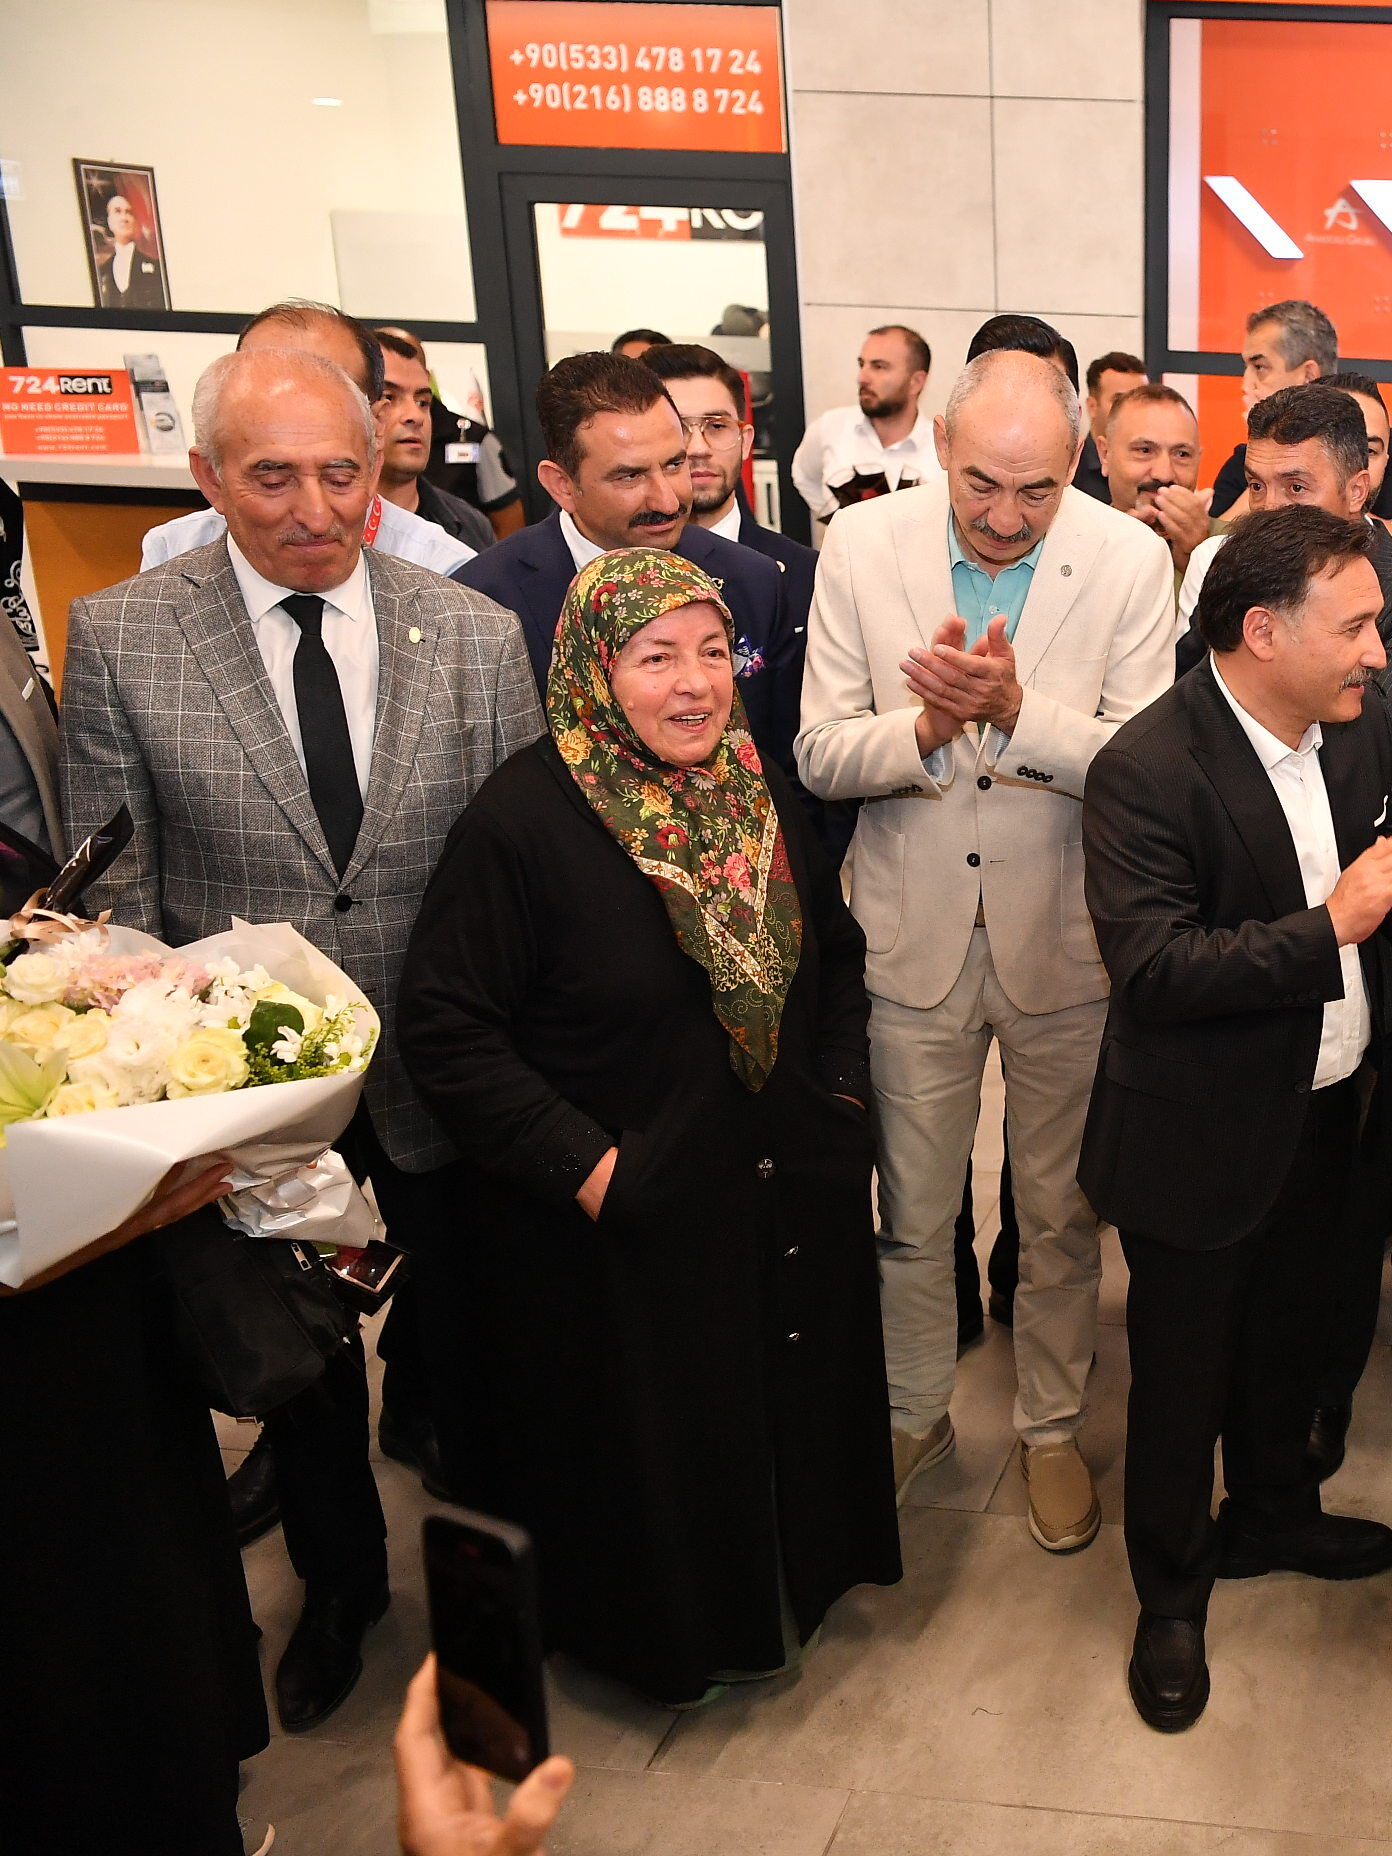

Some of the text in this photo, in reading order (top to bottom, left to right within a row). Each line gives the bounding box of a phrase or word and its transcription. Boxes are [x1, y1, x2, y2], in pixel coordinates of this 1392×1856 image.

[508, 41, 763, 75] +90(533) 478 17 24
[512, 81, 765, 115] +90(216) 888 8 724
[20, 402, 52, 411] NEED
[54, 403, 95, 412] CREDIT
[97, 403, 129, 412] CARD
